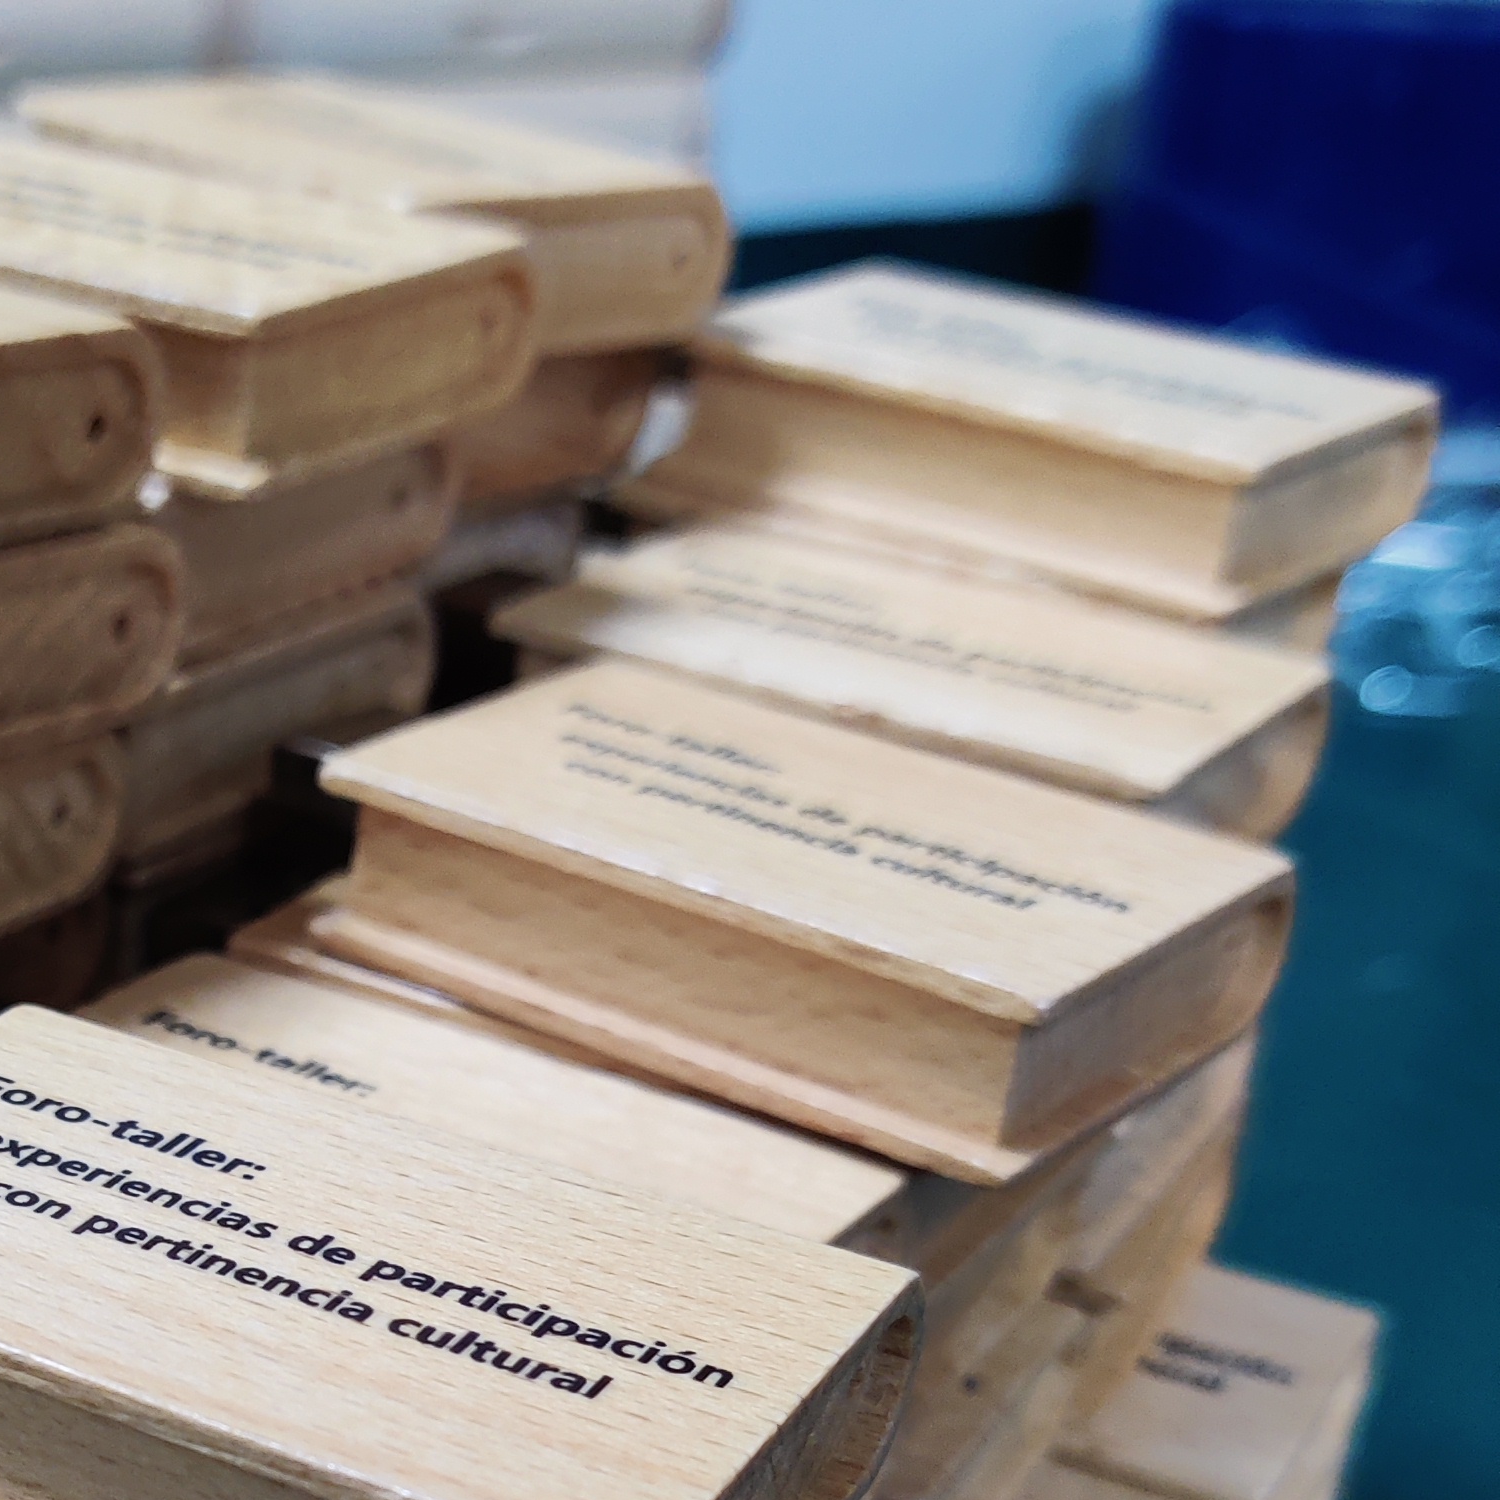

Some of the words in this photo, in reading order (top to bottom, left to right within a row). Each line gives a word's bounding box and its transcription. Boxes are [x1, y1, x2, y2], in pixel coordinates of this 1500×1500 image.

[142, 1009, 378, 1098] Foro-taller:
[70, 1214, 375, 1324] pertinencia
[387, 1317, 614, 1400] cultural
[287, 1234, 357, 1266] de
[357, 1259, 735, 1389] participación
